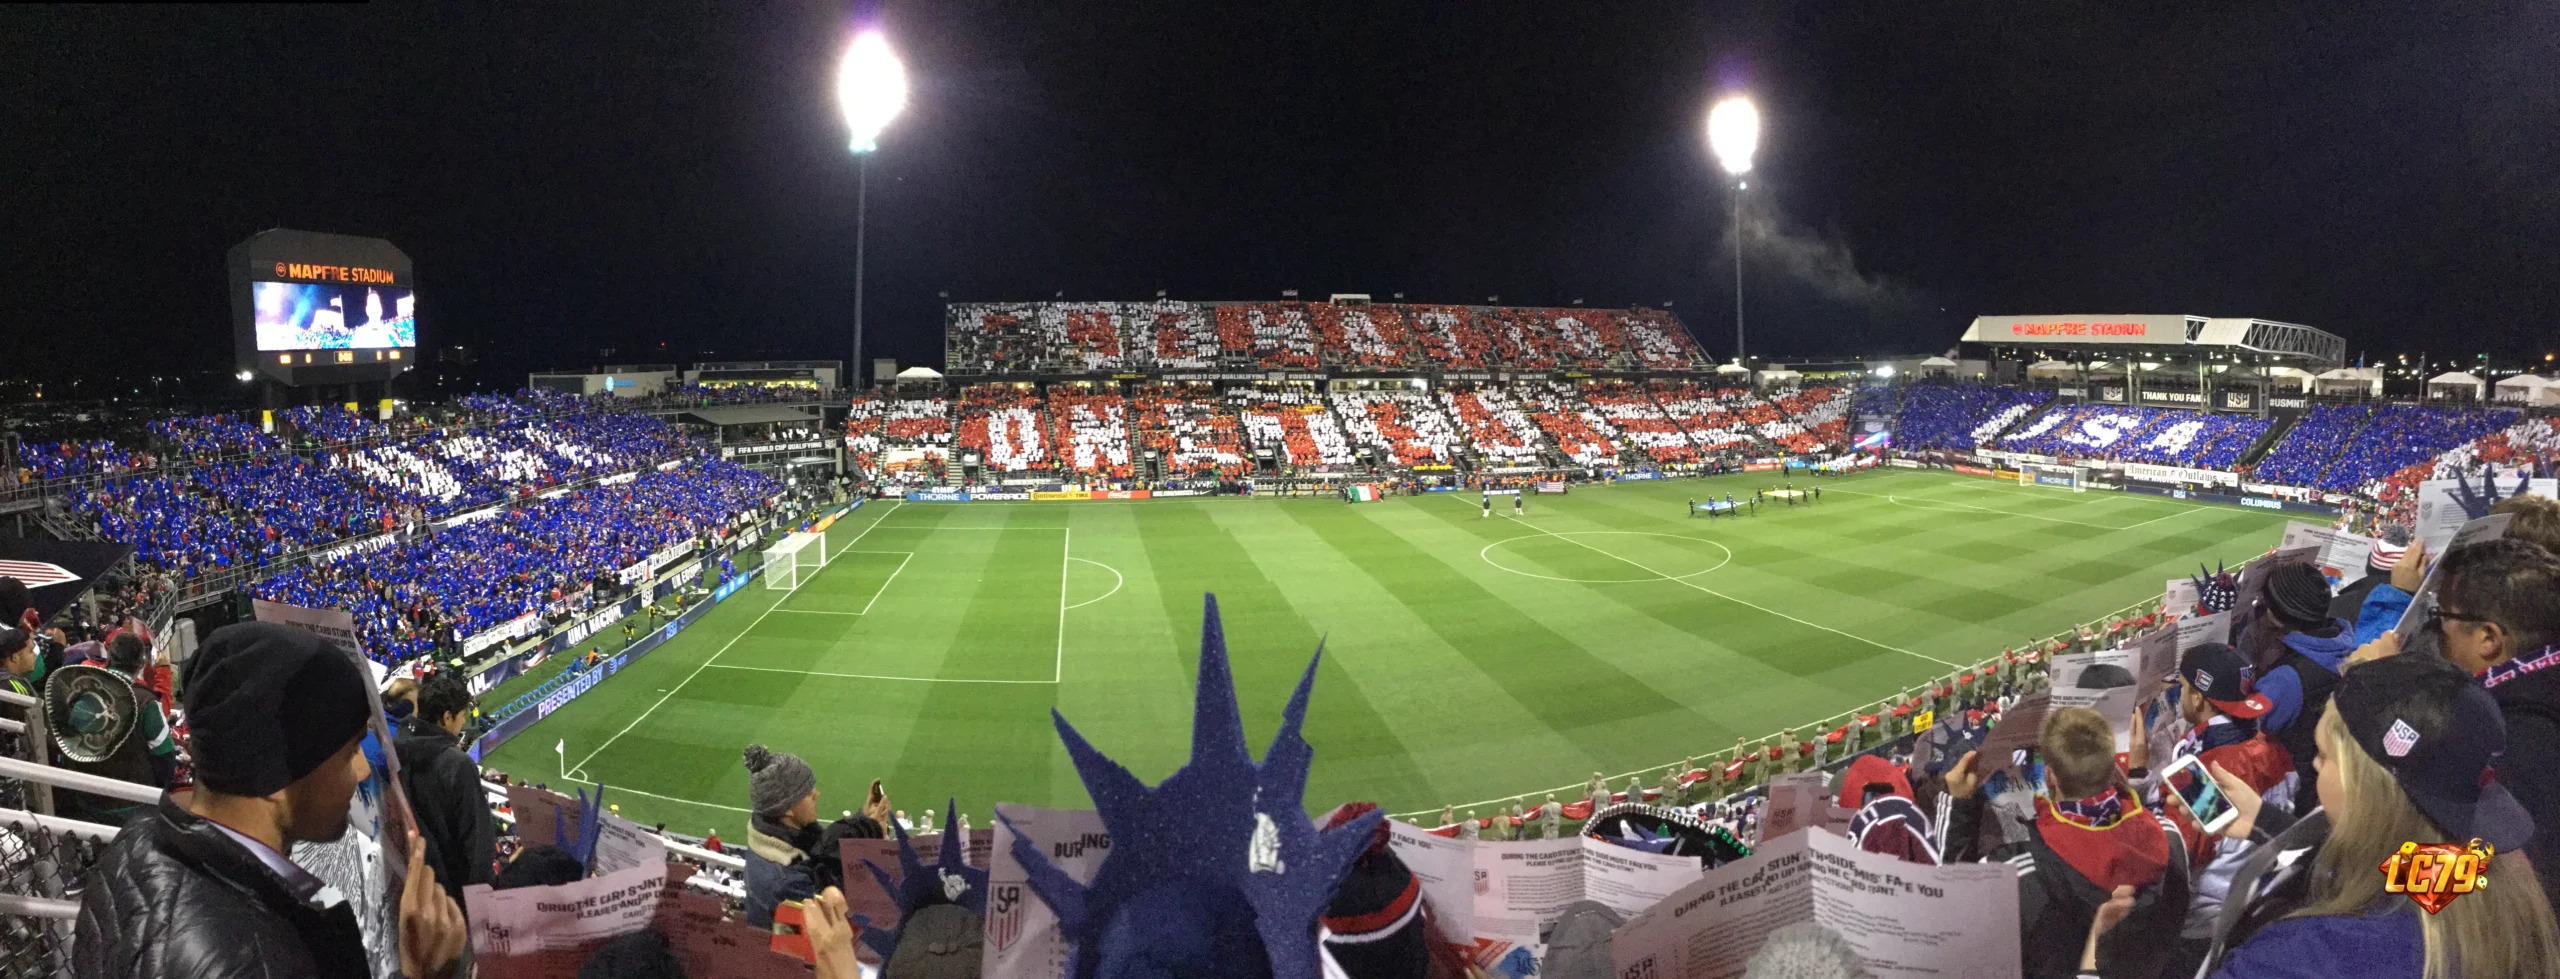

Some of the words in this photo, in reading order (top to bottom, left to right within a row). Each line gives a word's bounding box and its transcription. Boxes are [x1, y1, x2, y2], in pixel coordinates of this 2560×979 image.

[289, 263, 349, 281] MAPFRE
[351, 266, 394, 284] STADIUM
[2091, 323, 2146, 336] STADIUM
[2142, 391, 2167, 401] THANK
[2169, 392, 2184, 402] YOU
[2269, 398, 2306, 409] #USMNT
[738, 446, 752, 454] FIFA
[752, 445, 774, 453] WORLD
[774, 443, 786, 451] CUP
[788, 441, 823, 450] QUALIFYING
[1624, 472, 1653, 480] THORNE
[2128, 464, 2168, 477] American
[2178, 469, 2218, 483] Outlaws
[1033, 491, 1068, 500] Continental
[2240, 497, 2282, 509] COLUMBUS
[353, 534, 396, 554] NATION
[305, 623, 316, 632] THE
[315, 625, 331, 636] CARD
[567, 626, 589, 645] UNA
[538, 676, 592, 720] PRESENTED
[591, 664, 604, 686] BY
[2394, 721, 2417, 742] USA
[1397, 833, 1416, 846] FACE
[1595, 851, 1610, 861] SIDE
[1610, 855, 1628, 865] MUST
[1781, 866, 1796, 879] UP
